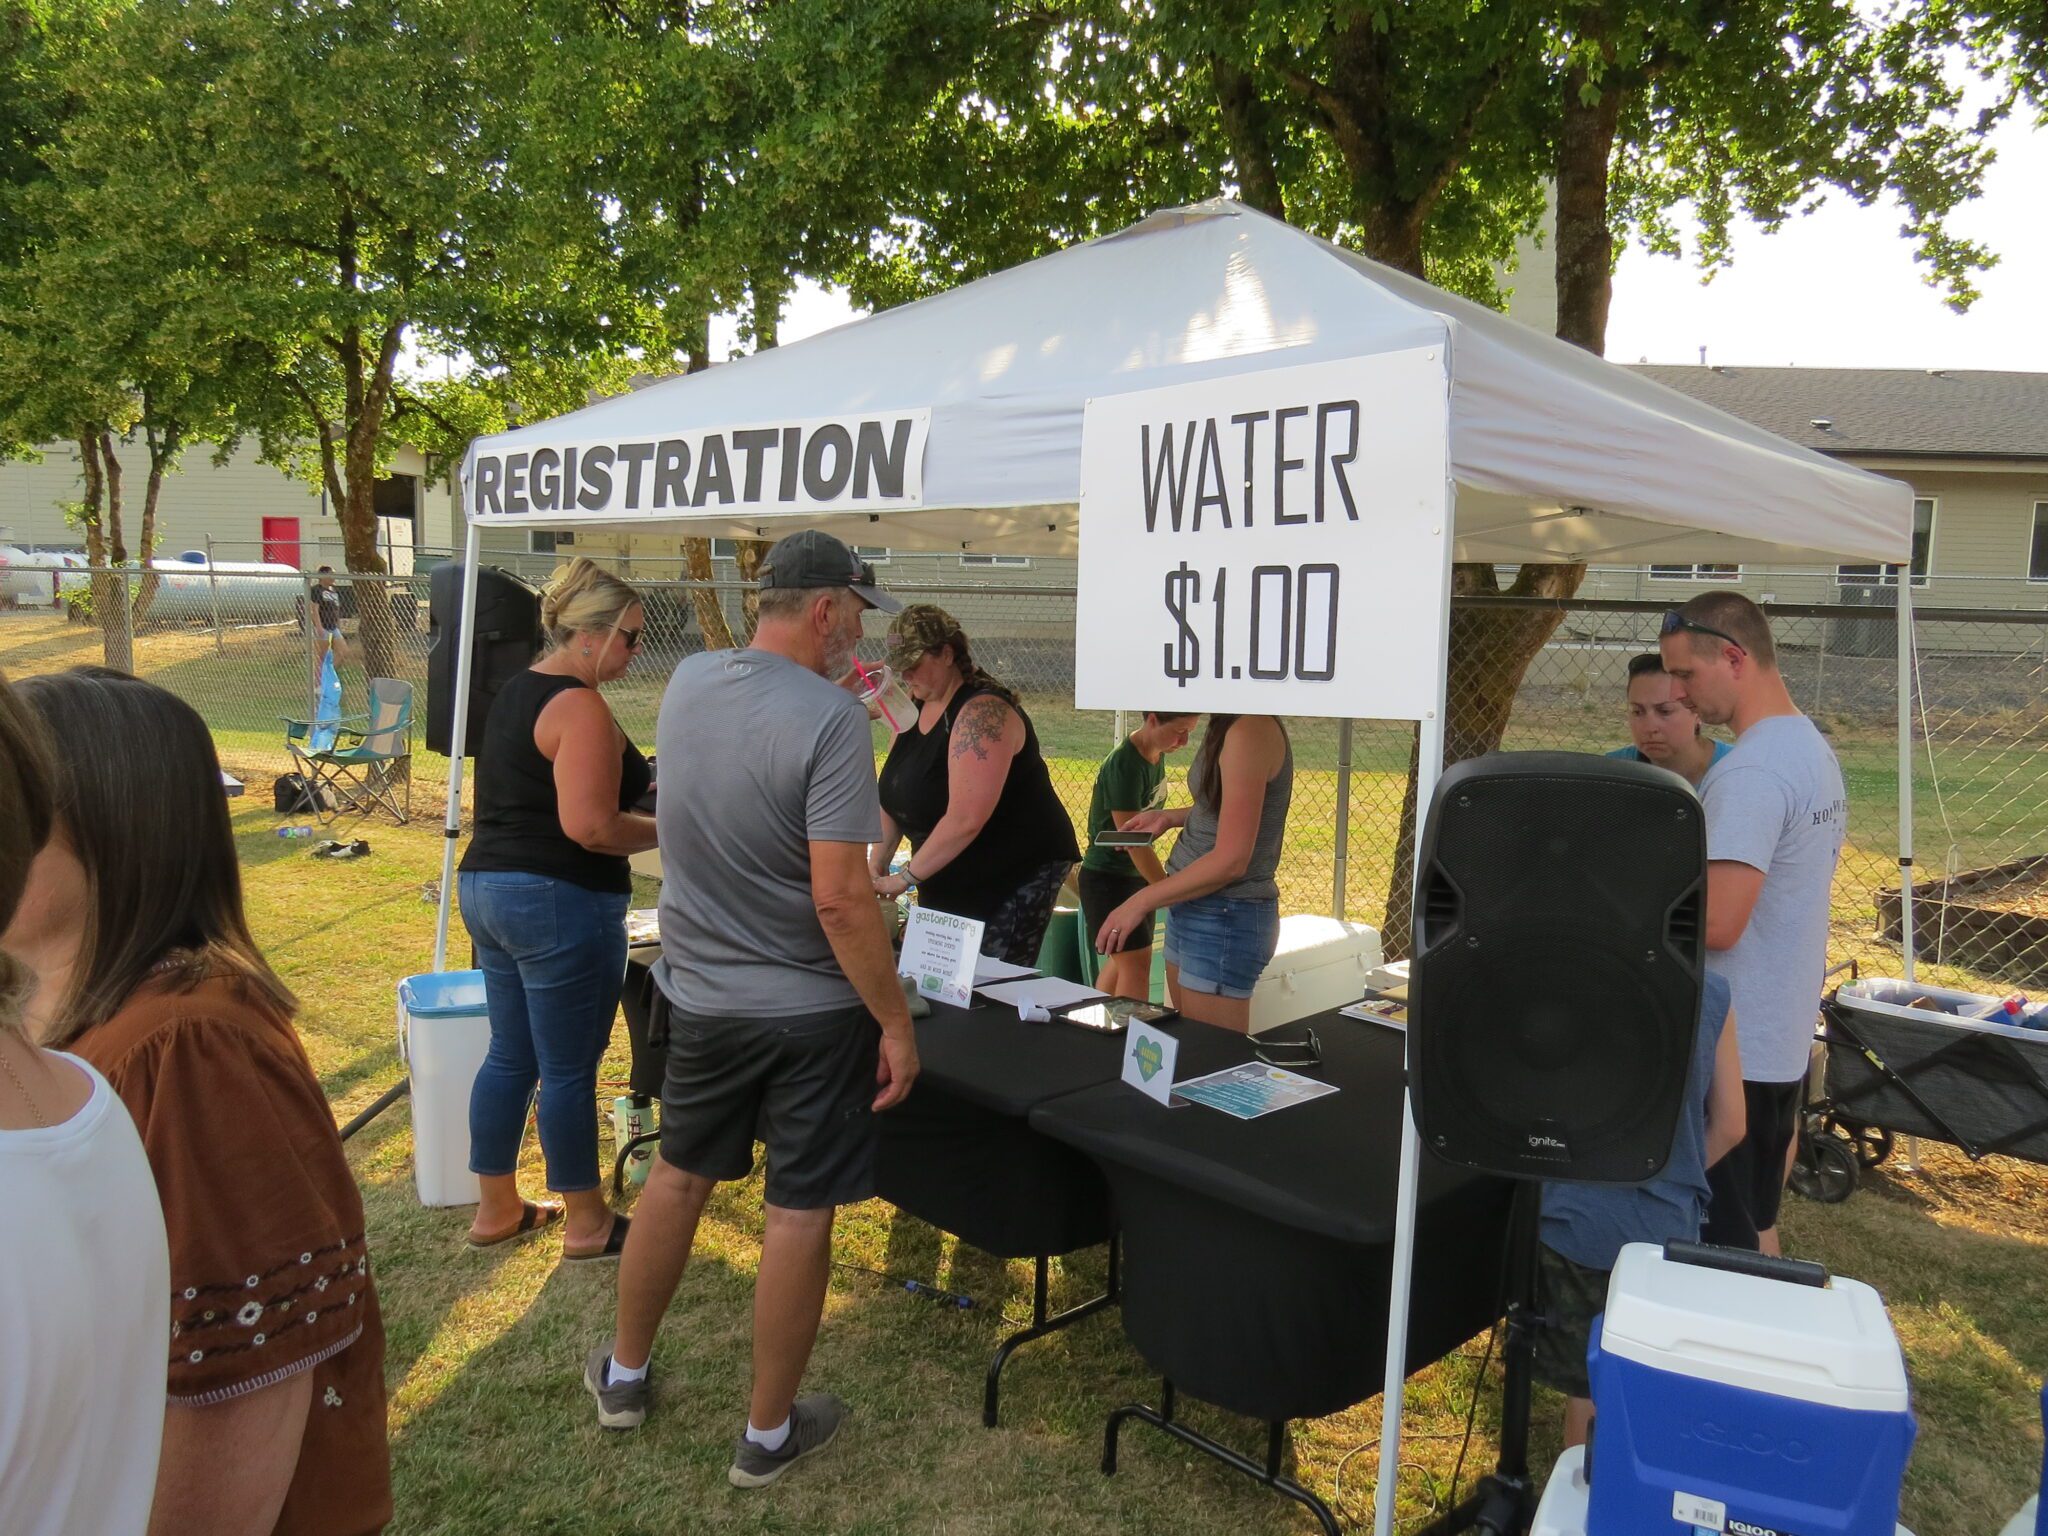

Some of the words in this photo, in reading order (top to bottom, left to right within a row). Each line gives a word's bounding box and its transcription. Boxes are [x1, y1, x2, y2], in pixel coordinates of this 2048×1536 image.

[475, 419, 912, 515] REGISTRATION
[1141, 400, 1360, 532] WATER
[1164, 561, 1340, 688] $1.00
[915, 911, 976, 937] gastonPTO.org
[1528, 1134, 1558, 1147] ignite
[1680, 1416, 1812, 1463] IGLOO
[1728, 1519, 1777, 1536] IGLOO
